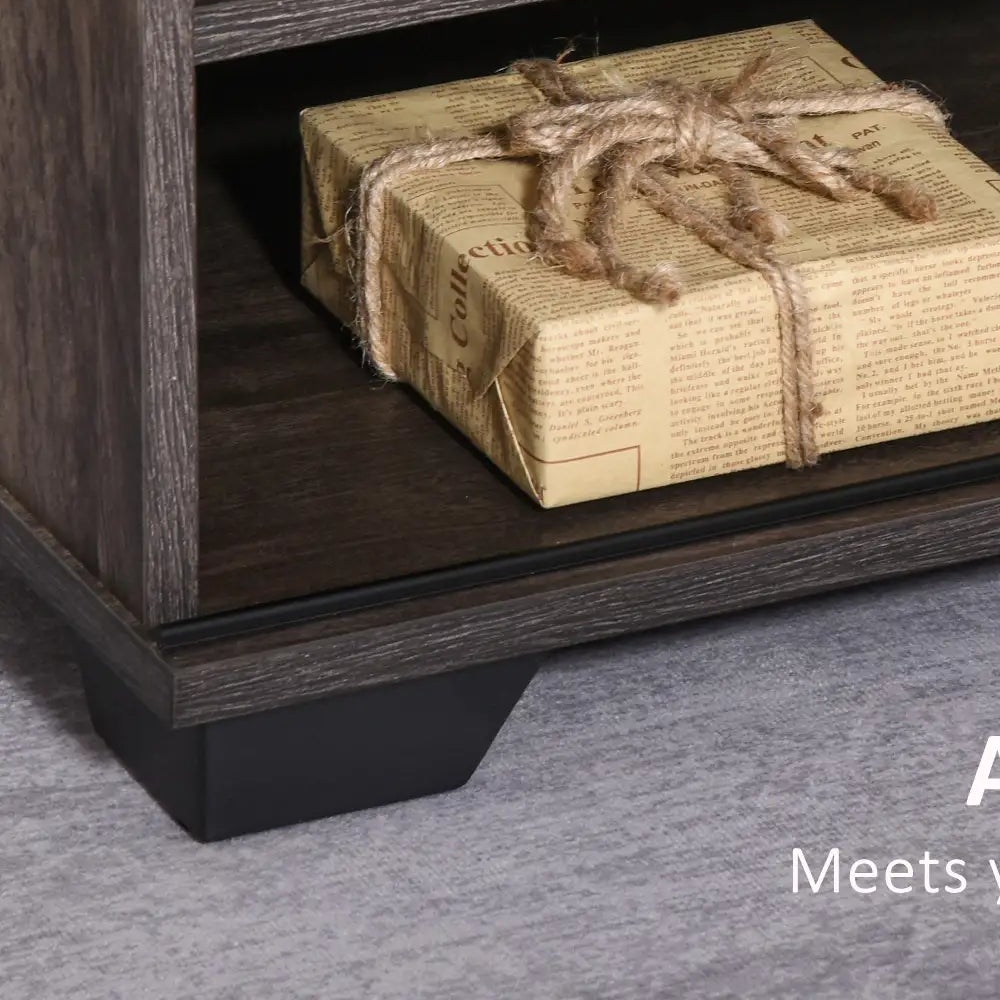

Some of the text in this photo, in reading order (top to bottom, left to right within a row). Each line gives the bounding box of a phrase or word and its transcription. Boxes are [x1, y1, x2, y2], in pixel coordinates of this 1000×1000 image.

[957, 327, 989, 339] watched
[670, 352, 696, 361] Miami
[875, 376, 903, 385] winner
[936, 366, 952, 375] that
[869, 387, 898, 397] usually
[905, 382, 918, 390] bet
[923, 380, 933, 388] by
[957, 371, 980, 380] Name
[985, 408, 1000, 416] that
[821, 428, 844, 438] world
[683, 438, 697, 446] The
[701, 433, 722, 442] track
